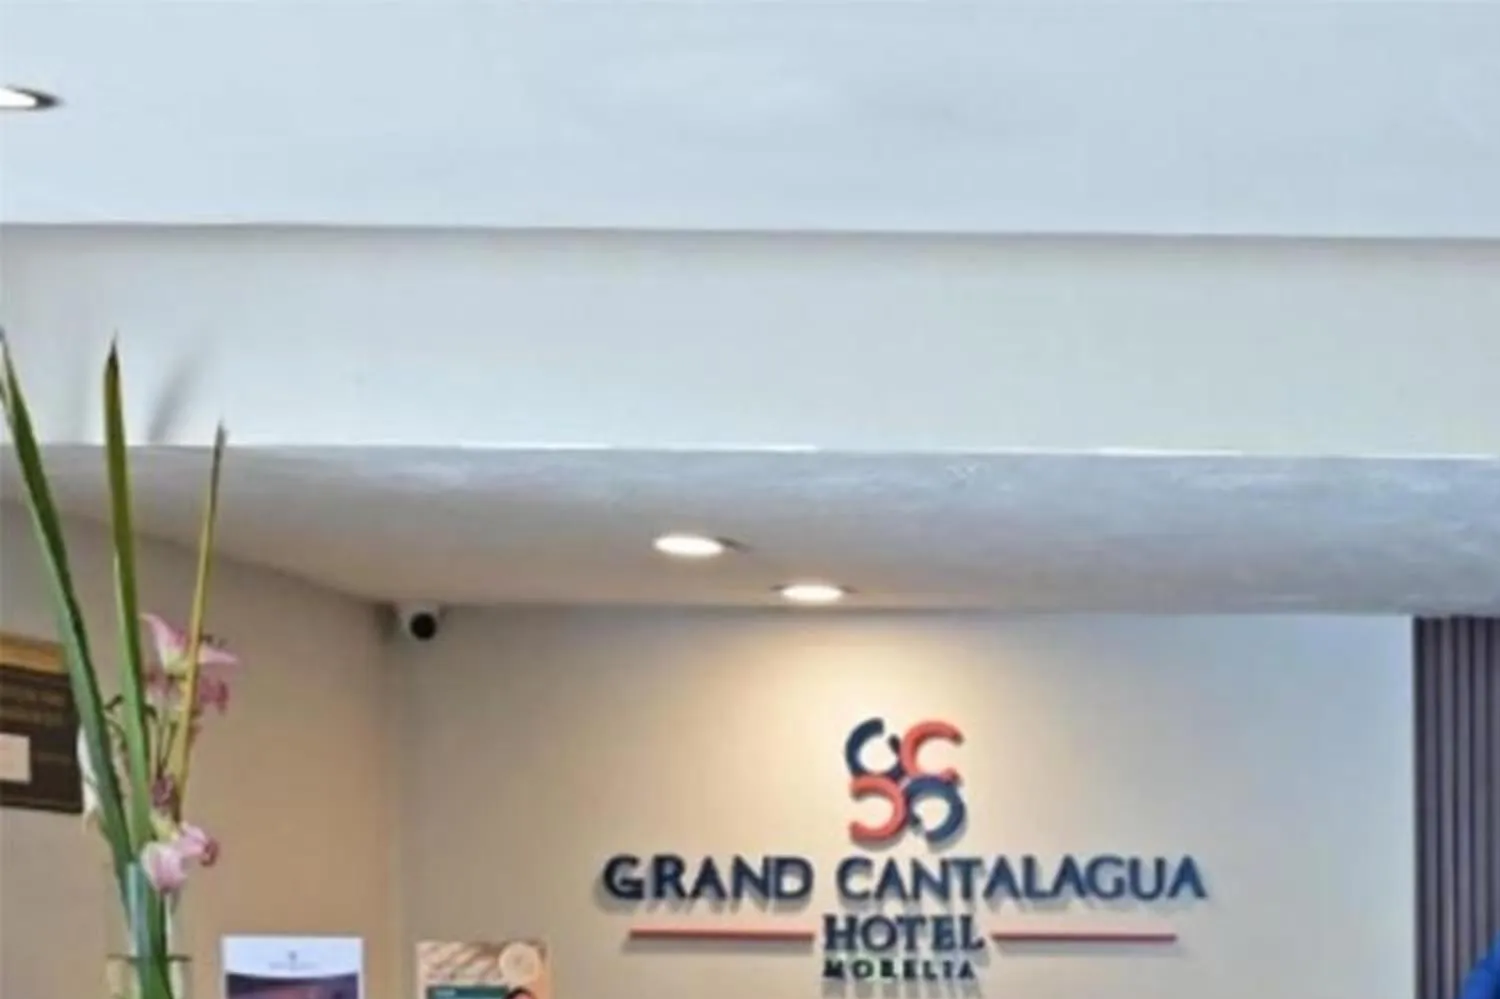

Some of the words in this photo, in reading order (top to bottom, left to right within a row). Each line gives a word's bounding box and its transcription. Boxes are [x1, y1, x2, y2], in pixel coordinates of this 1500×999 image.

[602, 853, 815, 901] GRAND
[836, 854, 1208, 901] CANTALAGUA
[822, 914, 985, 951] HOTEL
[822, 957, 976, 979] MORELIA
